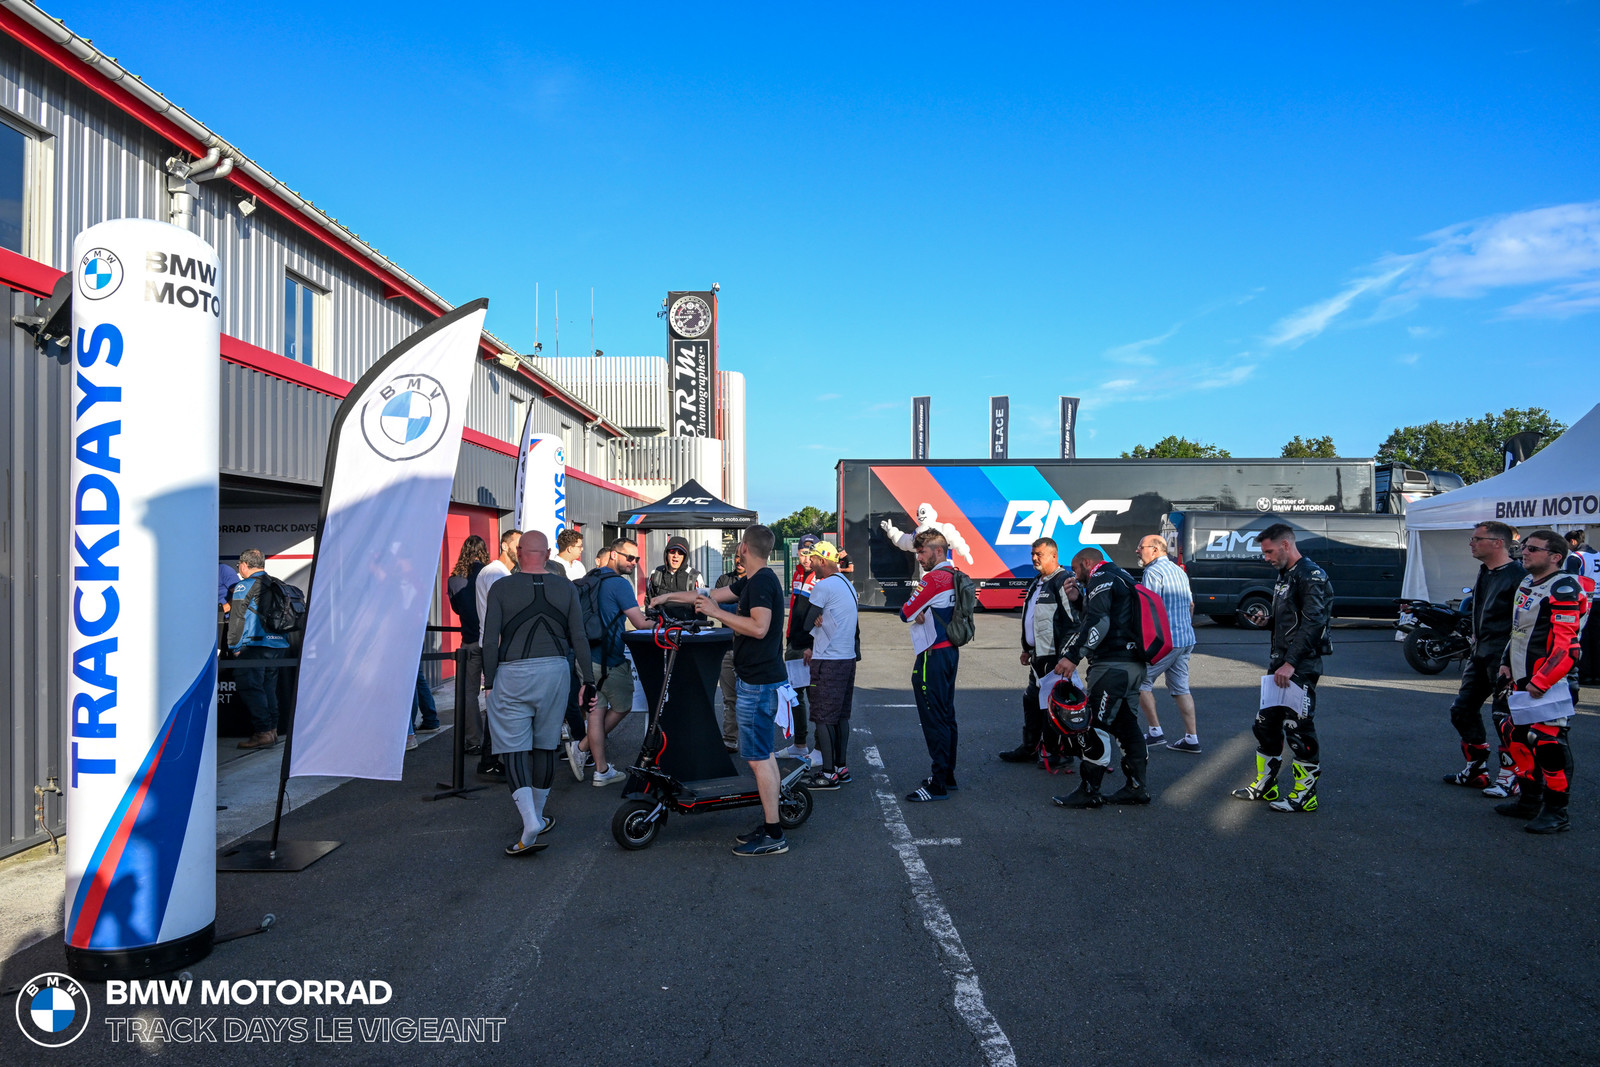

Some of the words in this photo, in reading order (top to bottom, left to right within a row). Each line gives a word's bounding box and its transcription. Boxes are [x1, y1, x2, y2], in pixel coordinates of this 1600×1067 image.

[145, 251, 217, 287] BMW
[995, 408, 1004, 453] PLACE
[667, 497, 713, 505] BMC
[1496, 500, 1536, 518] BMW
[1543, 495, 1600, 517] MOTO
[254, 524, 288, 532] TRACK
[291, 524, 317, 532] DAYS
[994, 500, 1132, 545] BMC
[72, 323, 124, 788] TRACKDAYS
[1206, 530, 1262, 552] BMC
[1097, 690, 1109, 722] IXON
